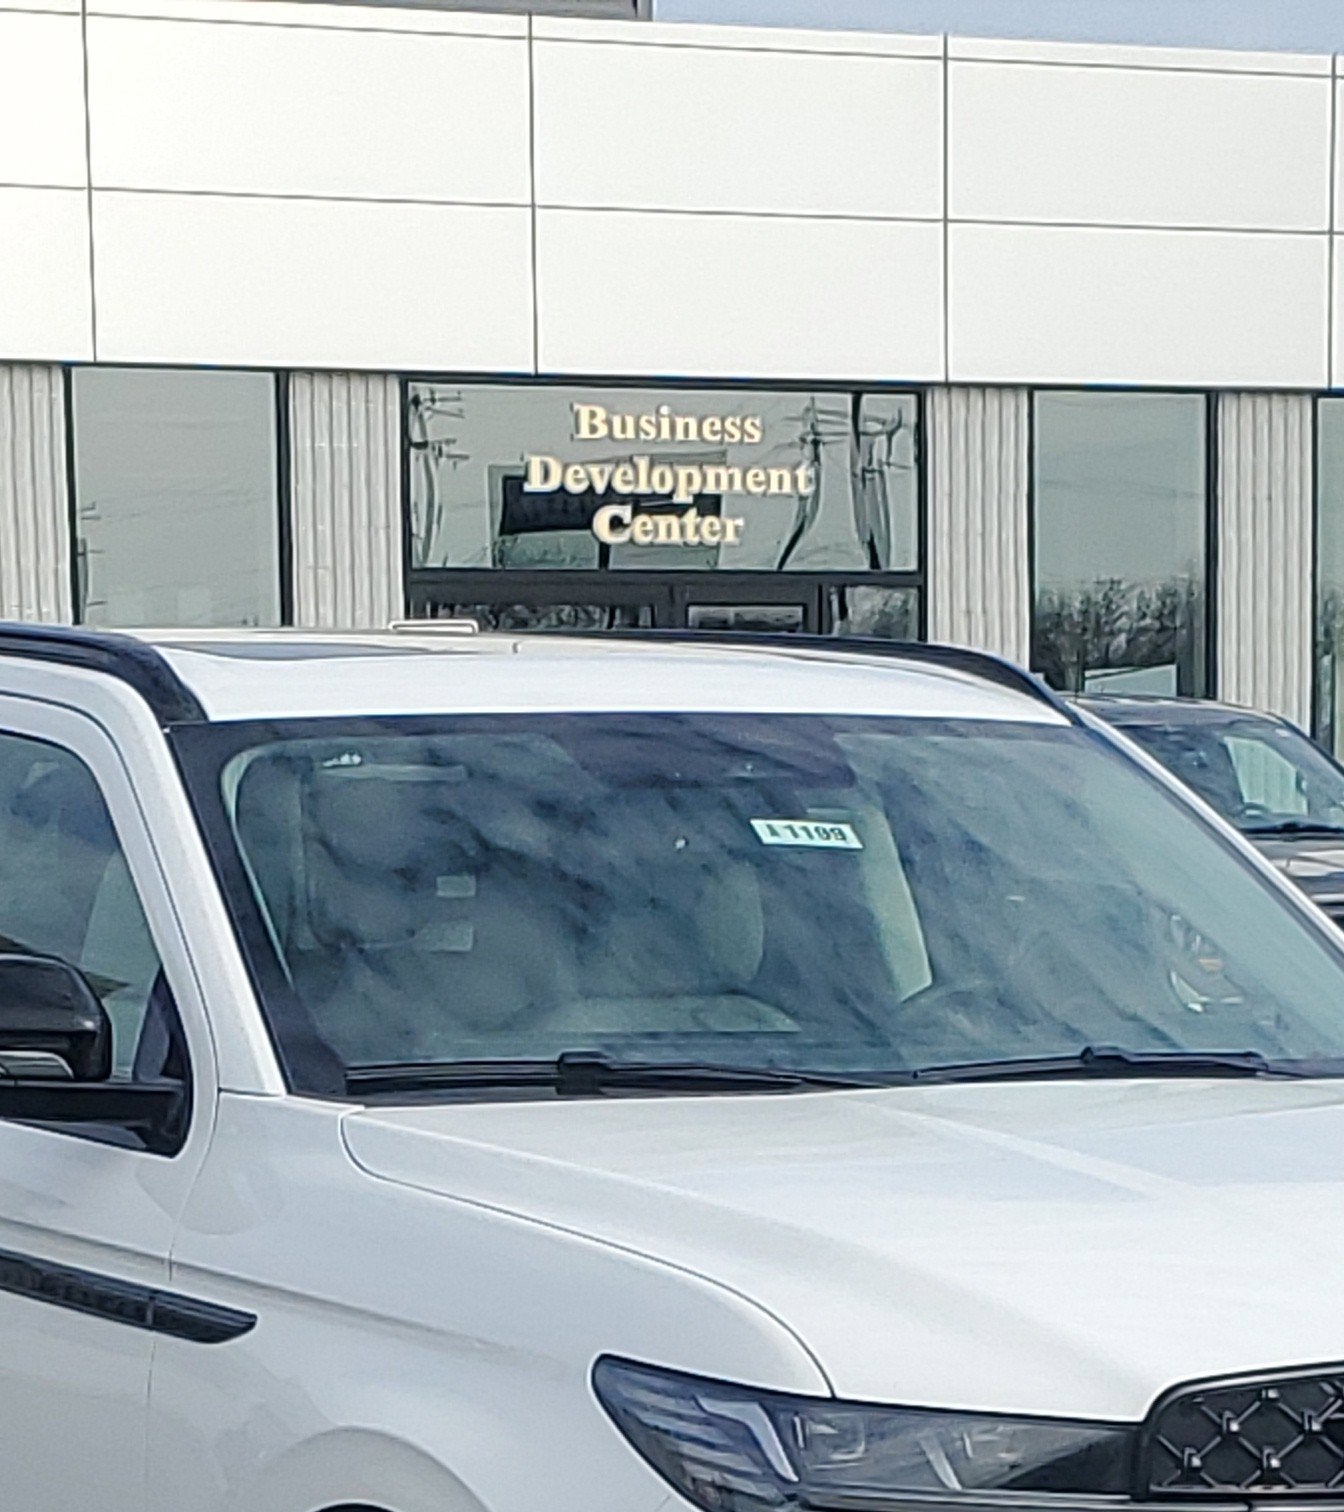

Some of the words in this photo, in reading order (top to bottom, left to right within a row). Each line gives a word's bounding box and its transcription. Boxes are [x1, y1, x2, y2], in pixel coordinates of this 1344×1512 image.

[572, 402, 762, 443] Business
[523, 455, 814, 503] Development
[593, 505, 744, 546] Center
